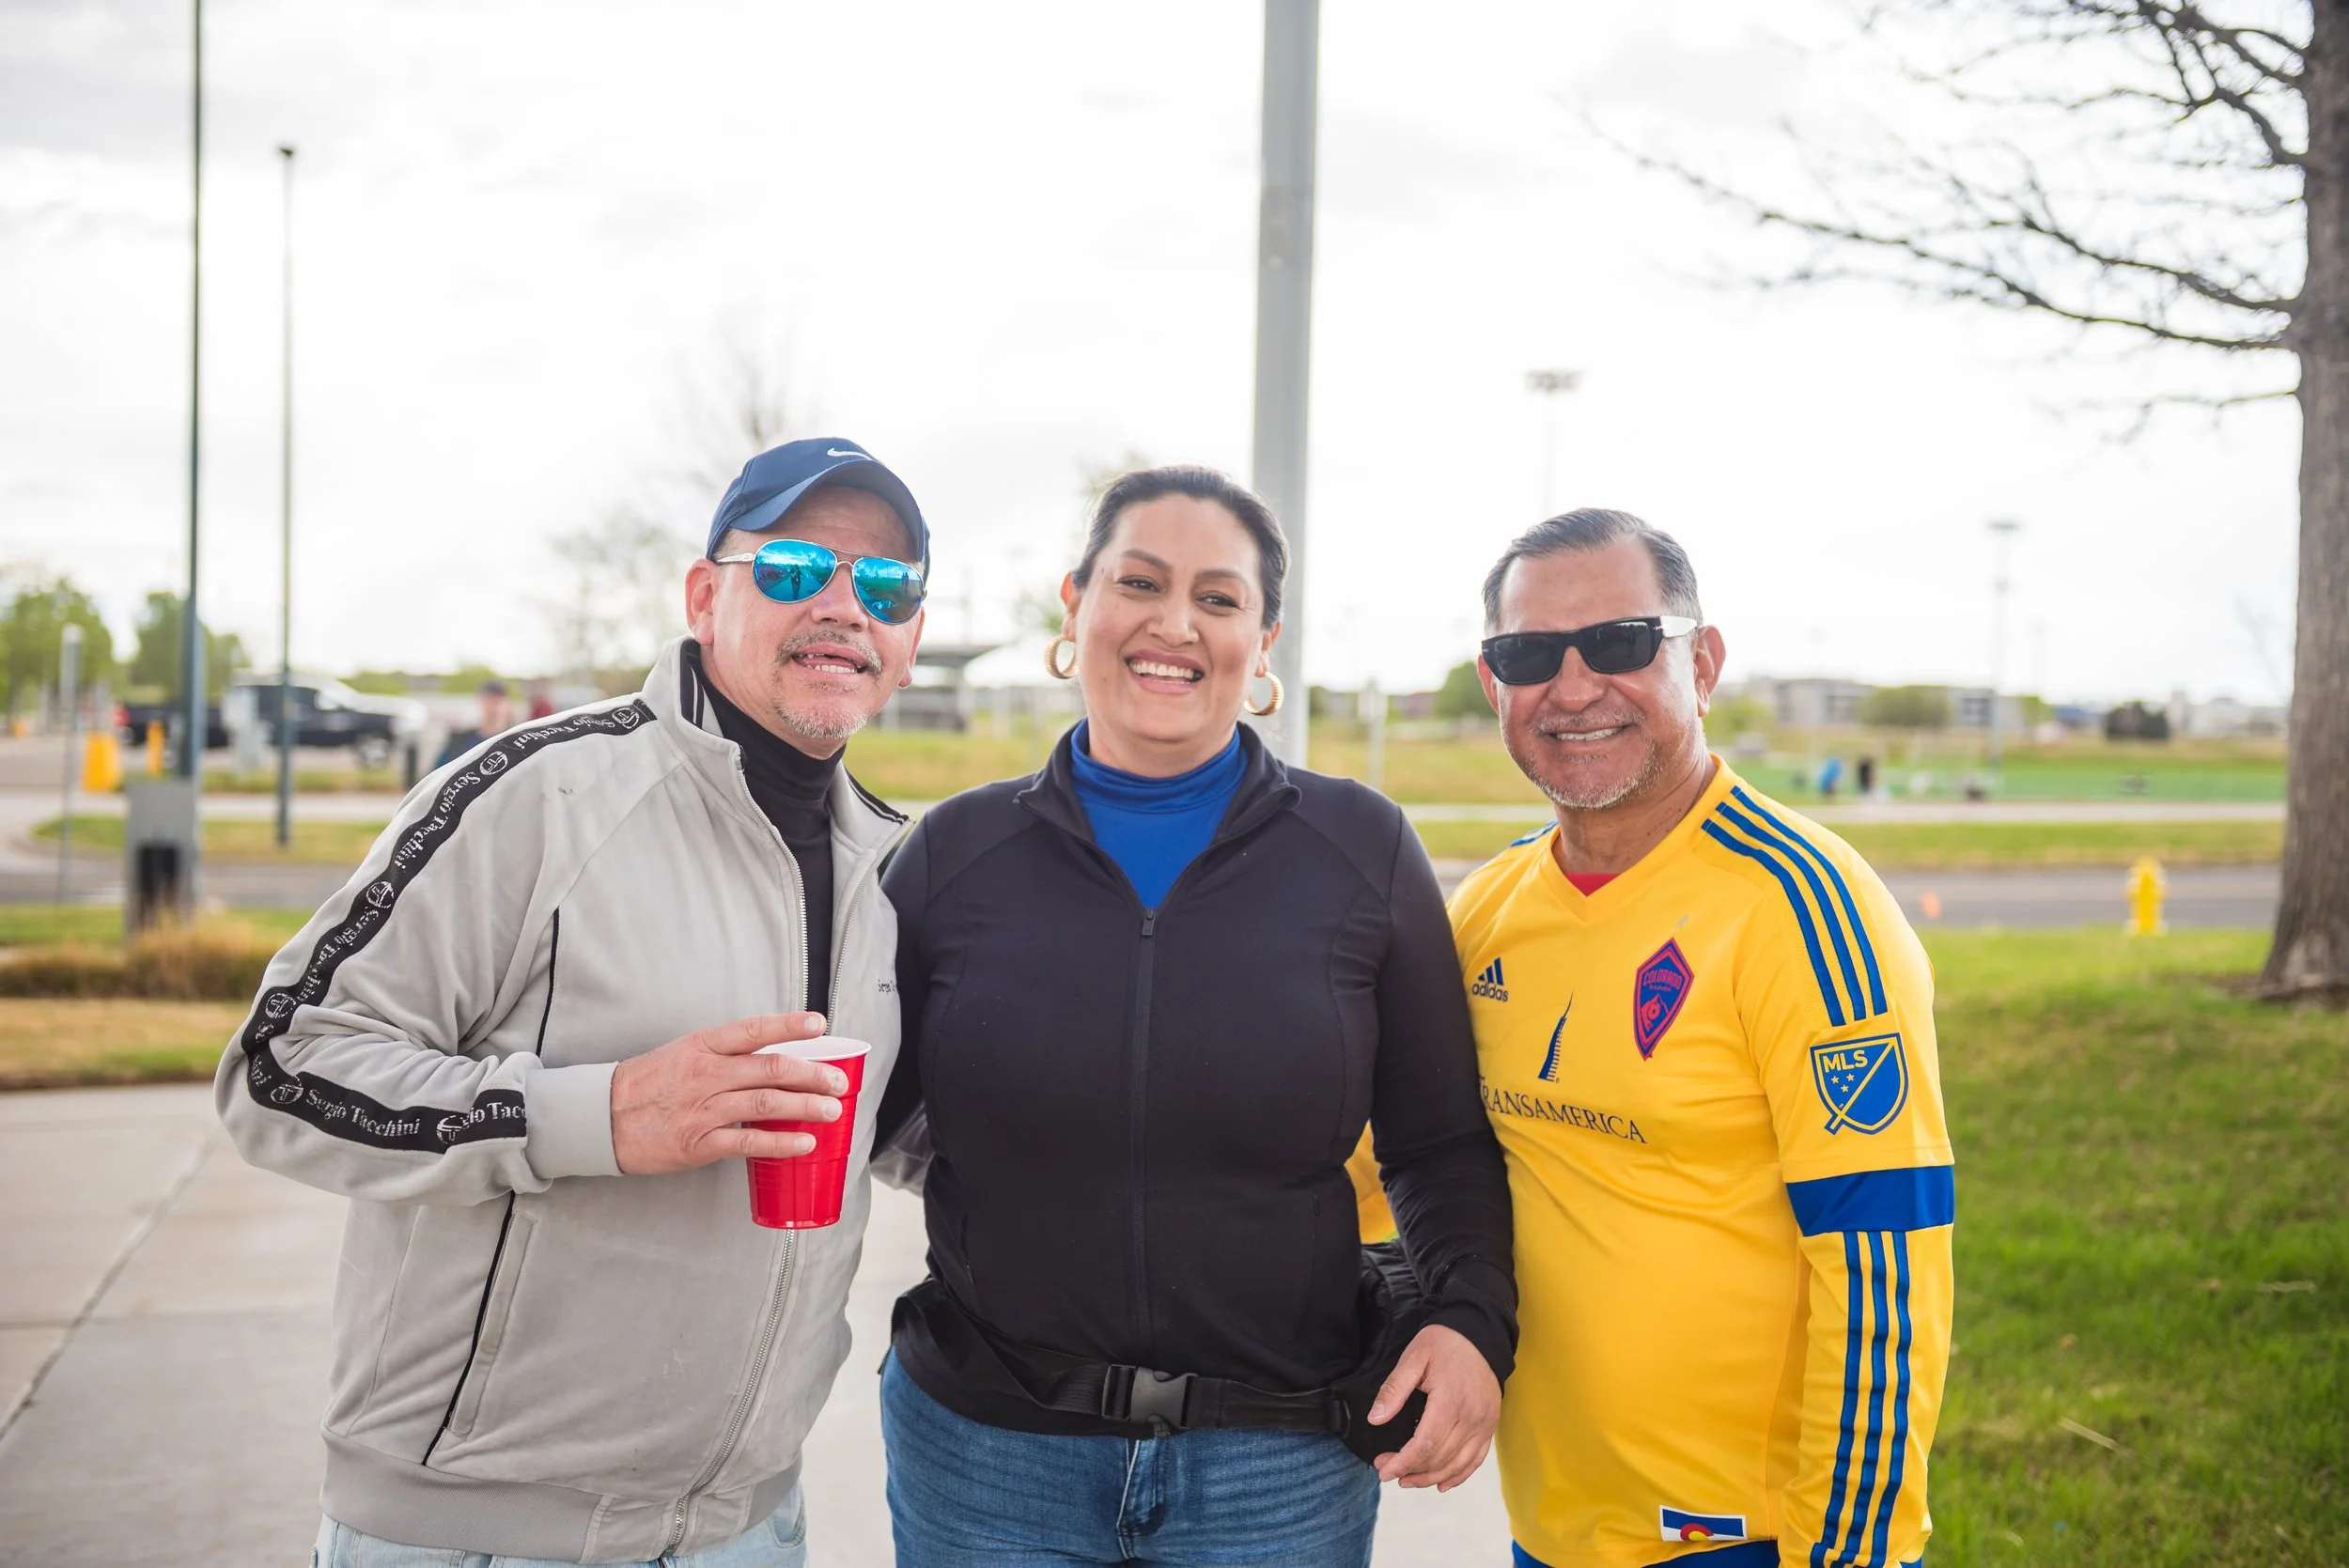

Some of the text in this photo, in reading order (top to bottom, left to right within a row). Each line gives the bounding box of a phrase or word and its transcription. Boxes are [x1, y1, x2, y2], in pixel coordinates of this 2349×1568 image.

[513, 726, 579, 750] Tacchini
[395, 771, 481, 869] Sergio Tacchini
[1642, 969, 1683, 990] COLORADO
[1472, 983, 1509, 1002] adidas
[1823, 1049, 1868, 1073] MLS
[306, 1089, 420, 1137] Sergio Tacchini
